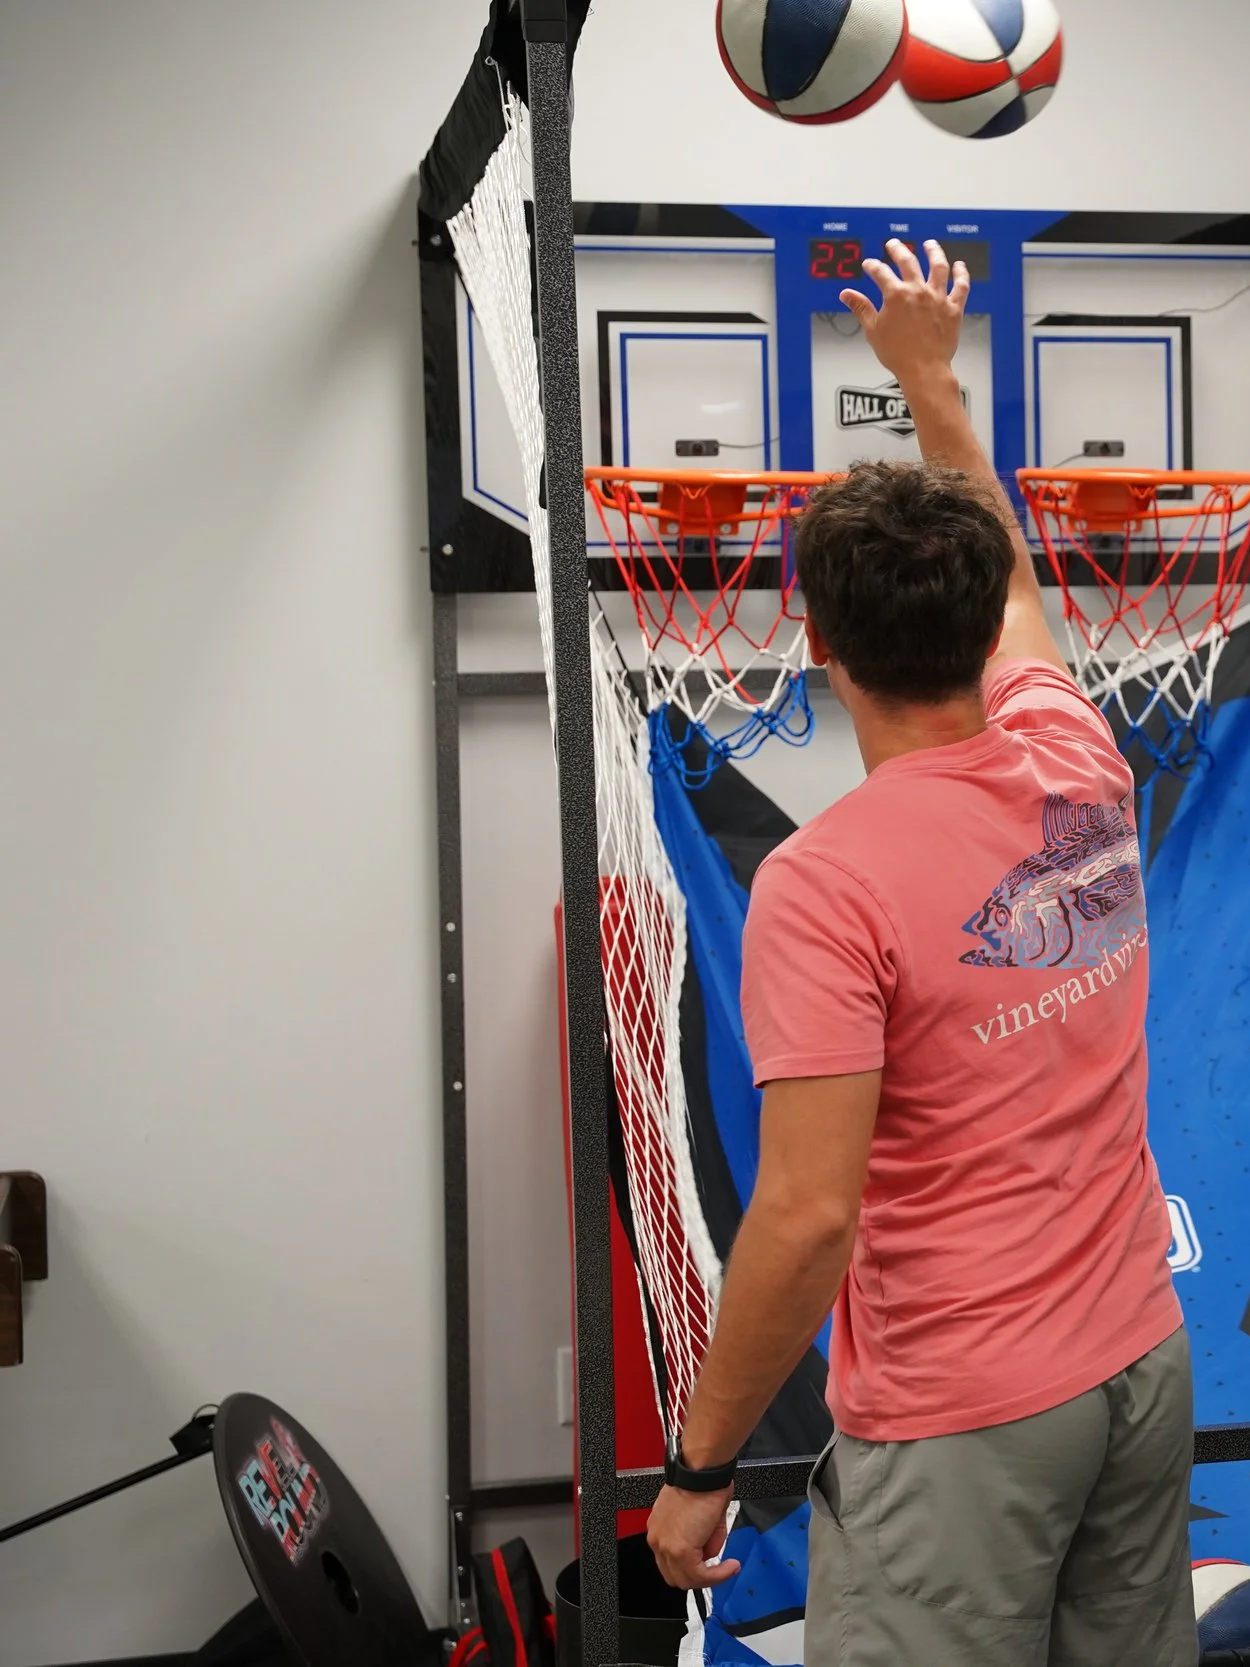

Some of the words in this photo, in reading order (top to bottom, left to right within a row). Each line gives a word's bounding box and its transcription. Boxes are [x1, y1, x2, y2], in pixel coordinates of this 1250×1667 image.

[823, 222, 848, 232] HOME
[889, 223, 910, 233] TIME
[946, 224, 979, 234] VISITOR
[810, 243, 861, 279] 22
[842, 393, 883, 424] HALL
[885, 398, 908, 418] OF
[971, 948, 1118, 1045] vineyard
